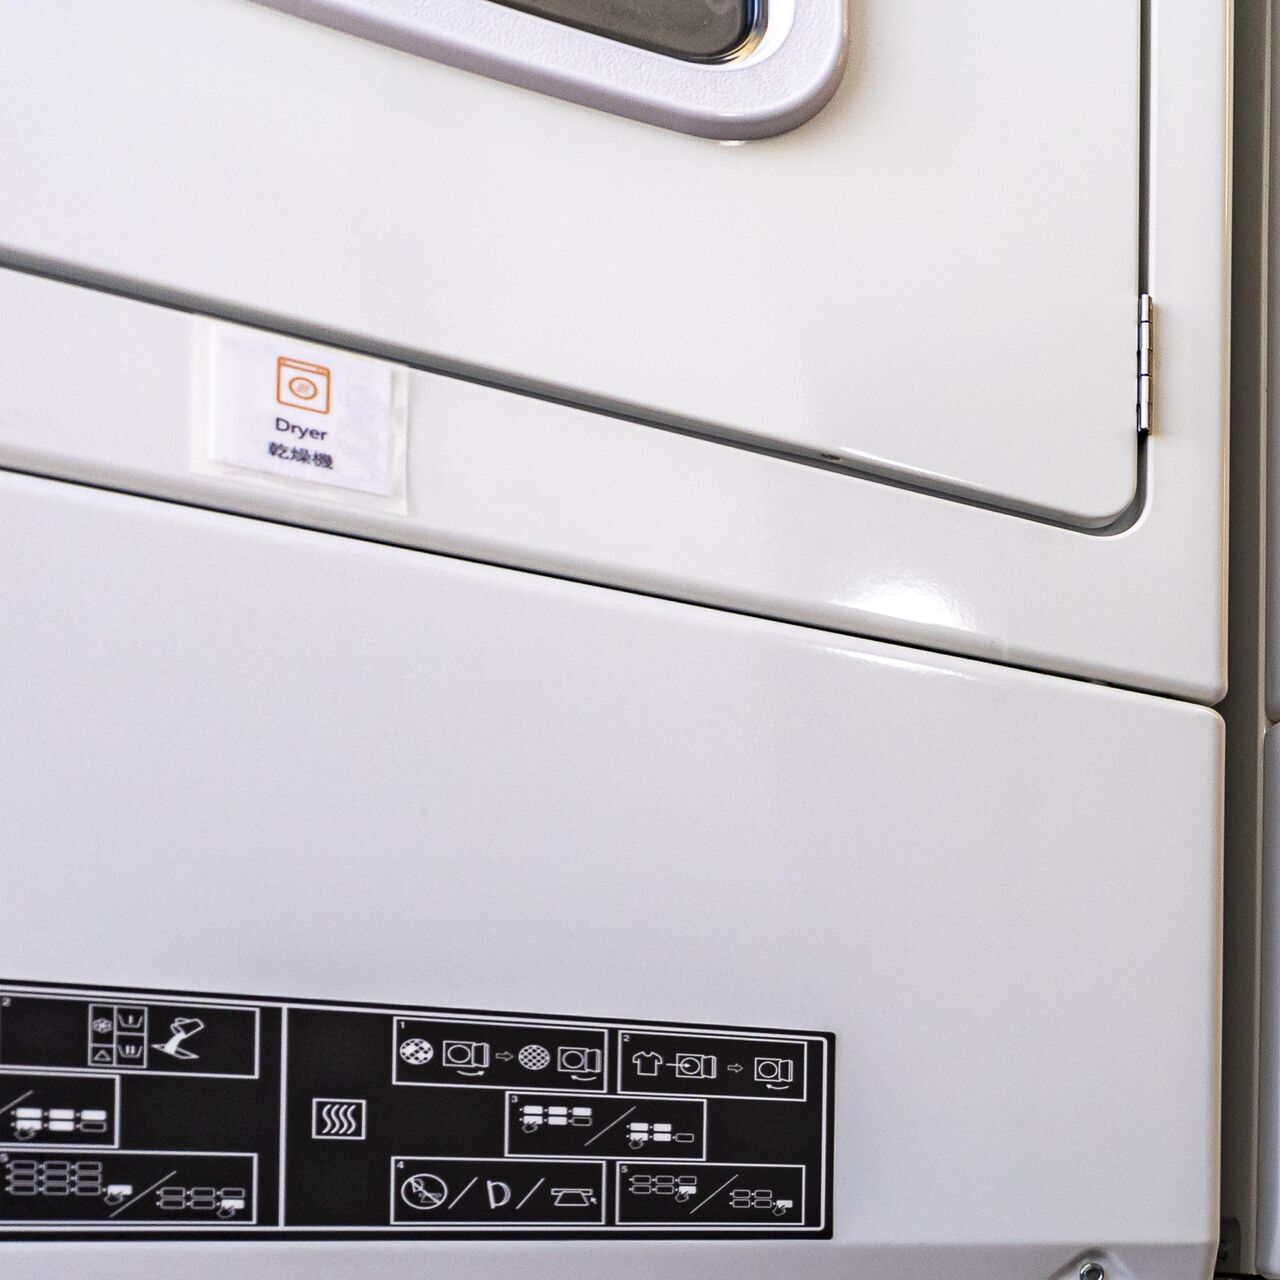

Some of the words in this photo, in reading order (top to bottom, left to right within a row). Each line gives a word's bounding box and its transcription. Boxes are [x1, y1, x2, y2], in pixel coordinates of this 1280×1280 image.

[275, 417, 328, 440] Dryer
[268, 442, 334, 469] 乾燥機
